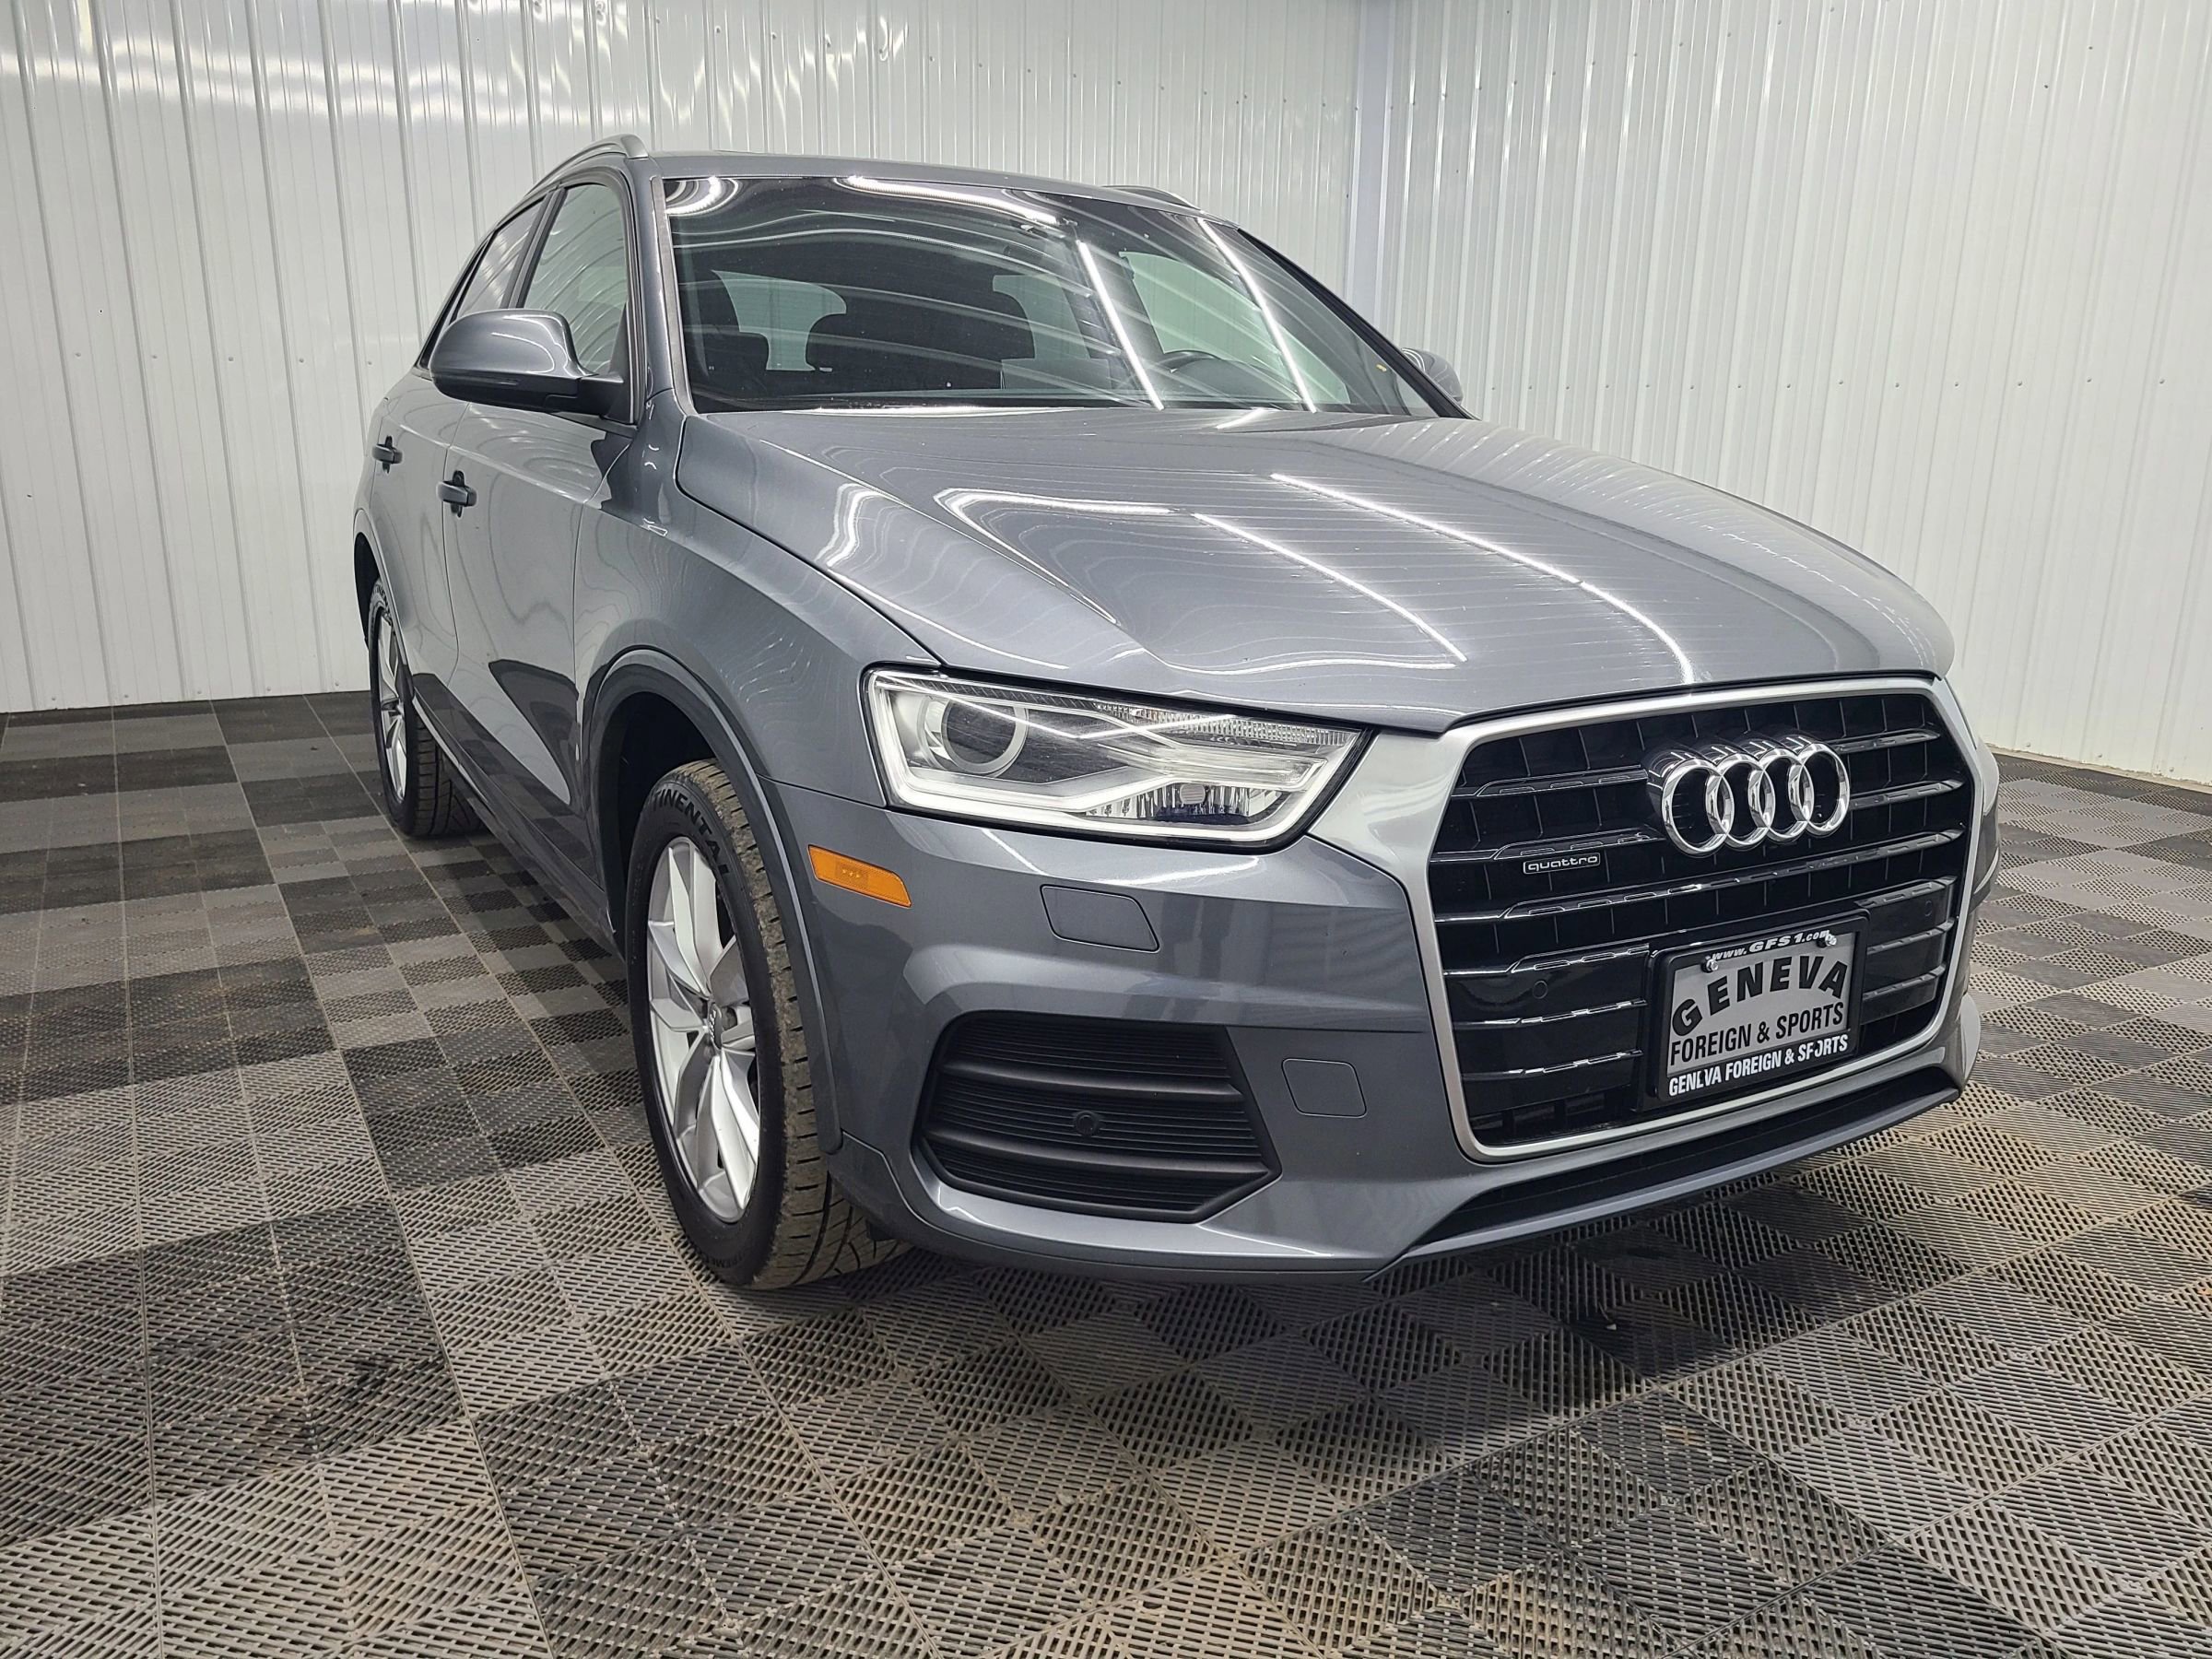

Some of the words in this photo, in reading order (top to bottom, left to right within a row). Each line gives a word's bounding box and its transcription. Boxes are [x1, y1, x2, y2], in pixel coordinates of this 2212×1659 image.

[1527, 855, 1598, 872] quattro
[1672, 955, 1848, 1037] GENEVA
[1670, 1023, 1751, 1065] FOREIGN
[1757, 1020, 1771, 1043] &
[1775, 1001, 1844, 1040] SPORTS
[1724, 1050, 1782, 1081] FOREIGN
[1784, 1048, 1795, 1065] &
